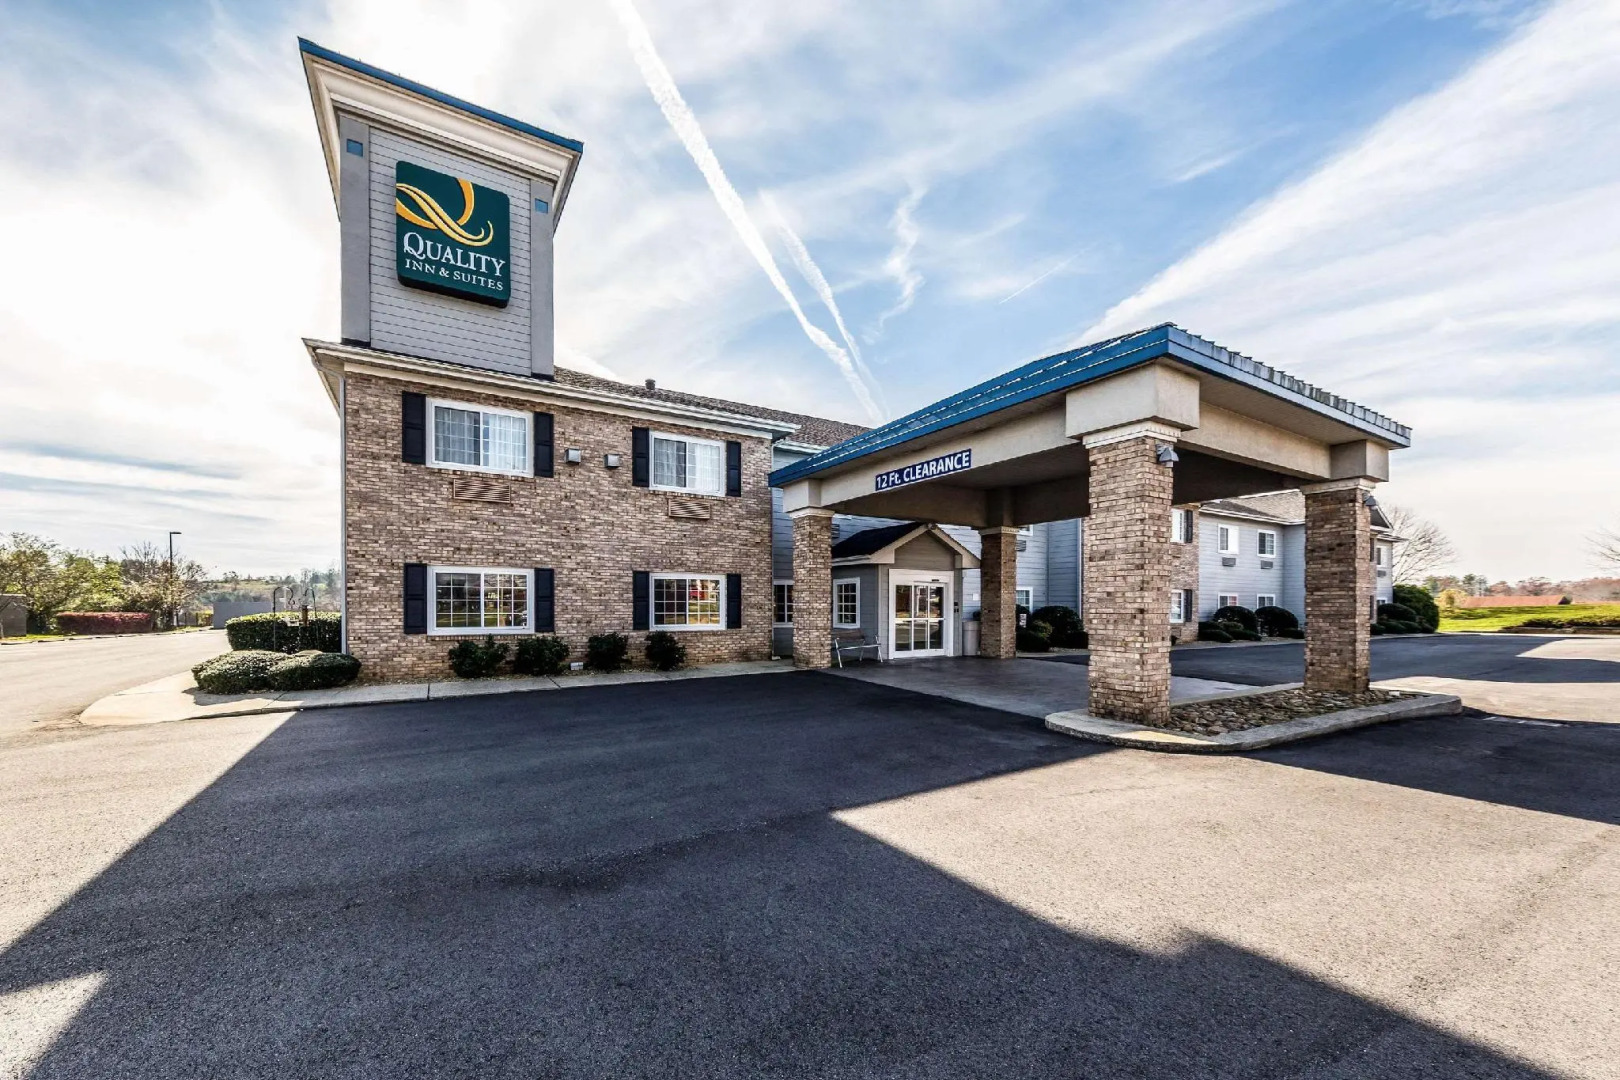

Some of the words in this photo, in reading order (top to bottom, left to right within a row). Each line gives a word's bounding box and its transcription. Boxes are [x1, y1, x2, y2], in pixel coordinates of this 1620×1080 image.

[403, 232, 506, 277] QUALITY
[405, 259, 436, 275] INN
[438, 267, 450, 278] &
[453, 270, 504, 291] SUITES
[903, 452, 970, 482] CLEARANCE
